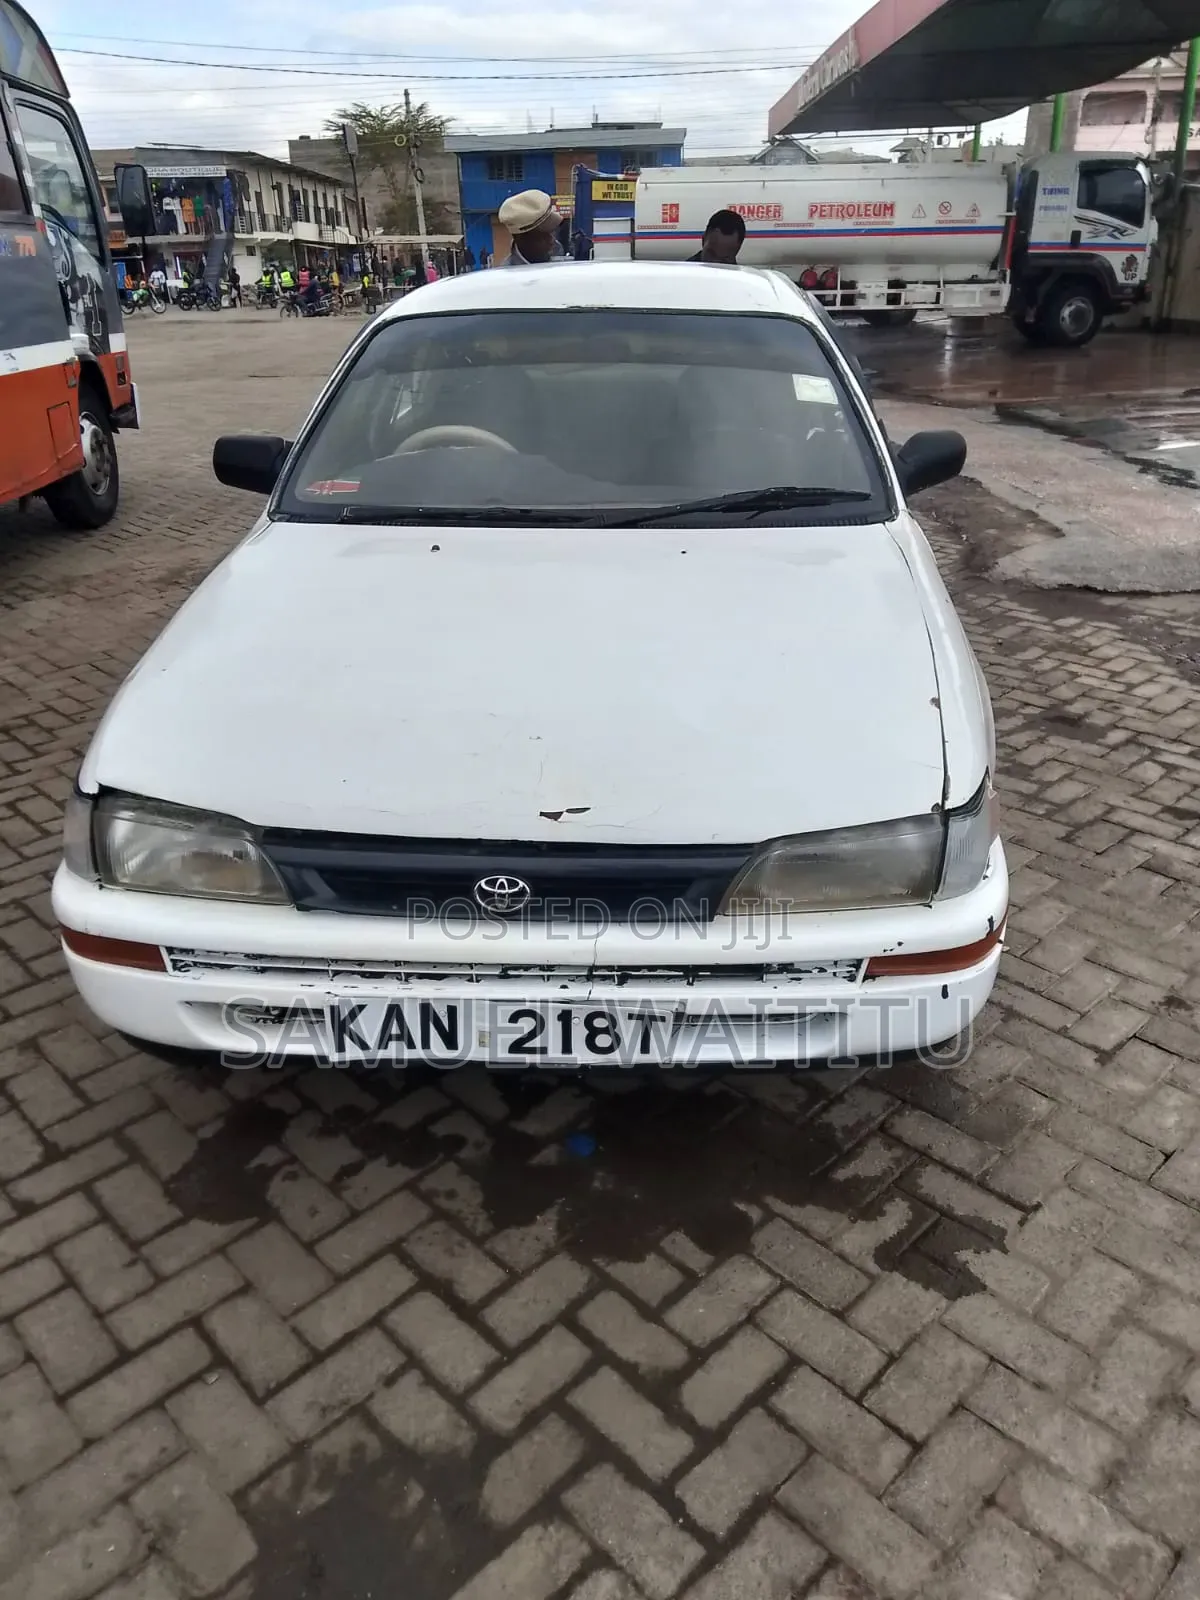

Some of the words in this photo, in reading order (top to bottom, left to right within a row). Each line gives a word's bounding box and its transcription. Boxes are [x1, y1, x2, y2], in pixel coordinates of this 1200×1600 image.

[809, 202, 896, 220] PETROLEUM
[330, 1002, 459, 1052] KAN
[507, 1008, 667, 1055] 218T
